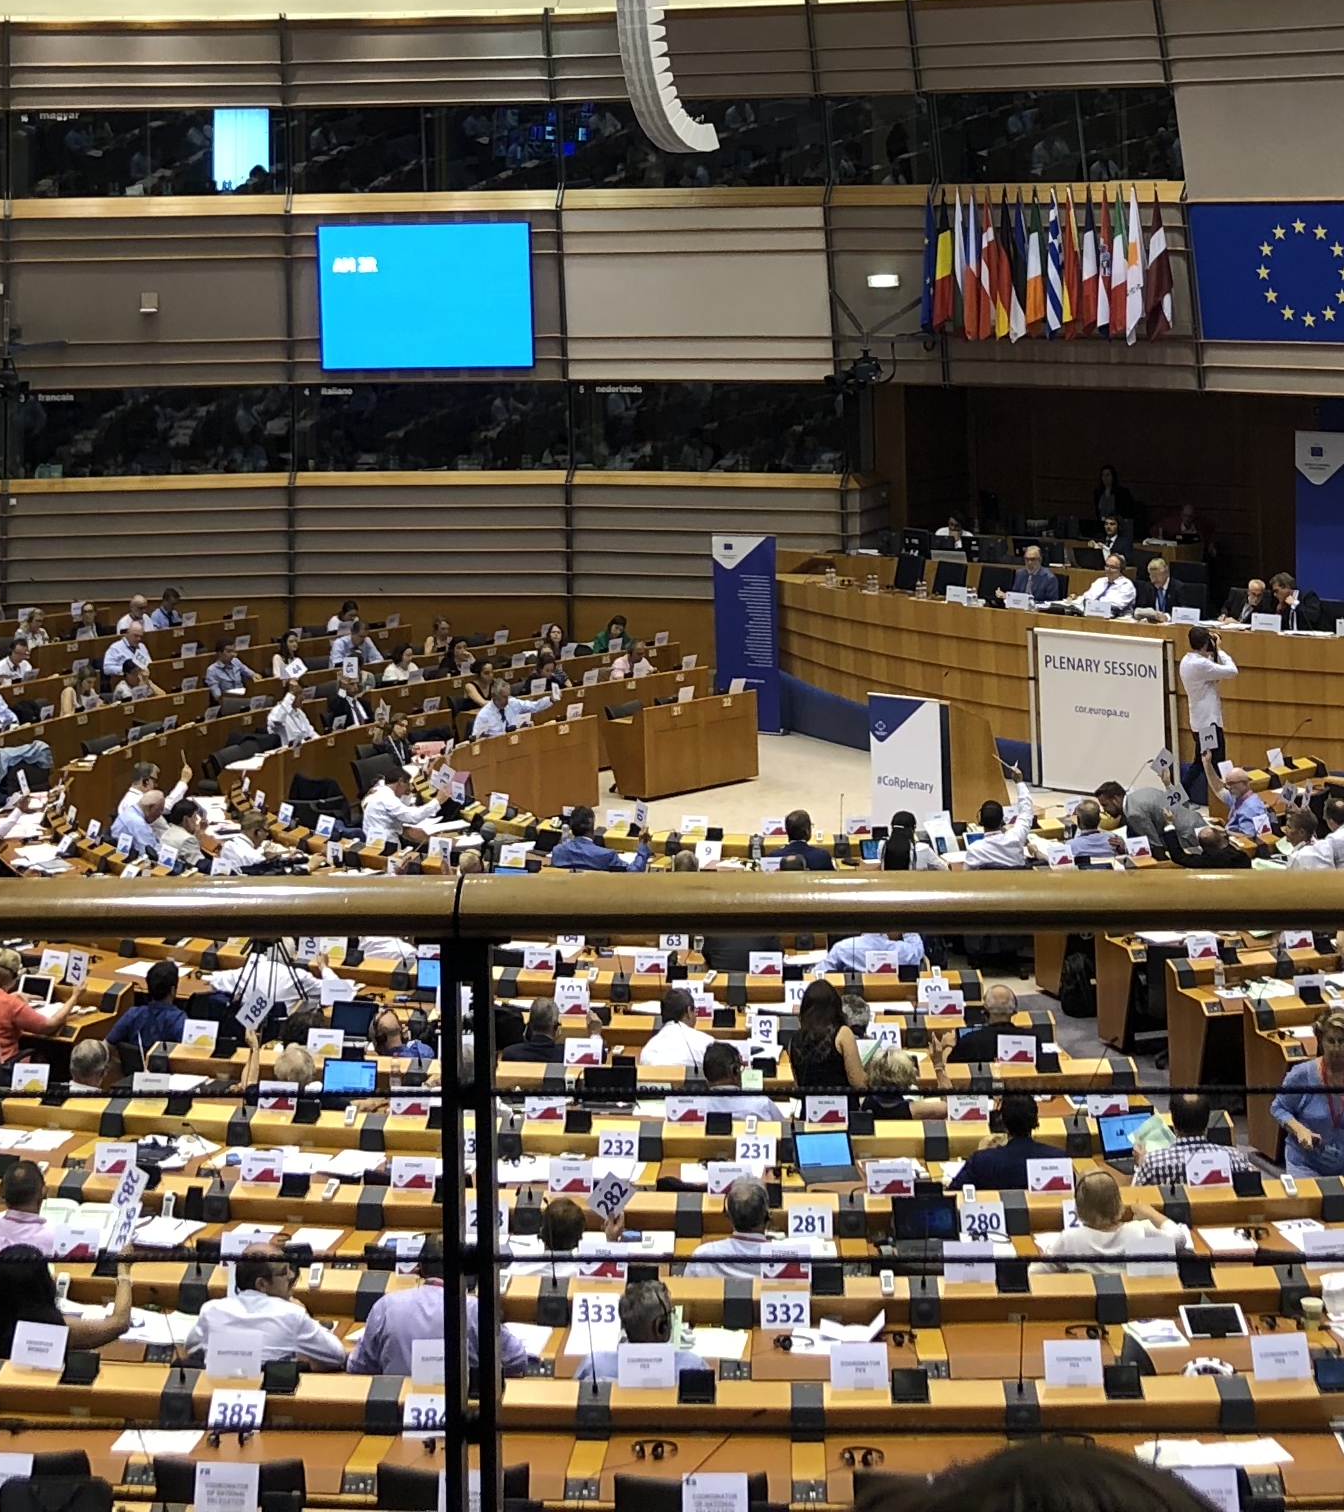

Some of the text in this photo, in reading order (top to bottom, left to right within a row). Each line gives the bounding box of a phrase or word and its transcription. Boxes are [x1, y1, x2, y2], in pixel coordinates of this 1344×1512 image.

[38, 110, 81, 122] magyar
[320, 386, 354, 395] italiano
[595, 384, 643, 394] nederlands
[20, 393, 26, 403] 3
[291, 665, 302, 675] 44
[345, 661, 355, 674] 45
[1044, 654, 1158, 679] PLENARY SESSION
[722, 696, 733, 707] 22
[1074, 704, 1130, 719] cor.europa.eu
[1204, 734, 1214, 742] 3
[1159, 758, 1168, 767] 4
[877, 775, 934, 794] #CoRplenary
[1166, 791, 1182, 806] 29
[704, 846, 712, 856] 9
[665, 934, 682, 947] 63
[70, 955, 84, 981] 147
[788, 987, 805, 1001] 10
[244, 995, 268, 1025] 188
[603, 1139, 634, 1156] 232
[740, 1144, 771, 1160] 231
[116, 1169, 140, 1206] 285
[596, 1181, 628, 1215] 282
[470, 1209, 504, 1227] 23
[792, 1214, 826, 1233] 281
[965, 1213, 1001, 1233] 280
[577, 1303, 616, 1323] 333
[765, 1303, 805, 1323] 332
[214, 1401, 258, 1429] 385
